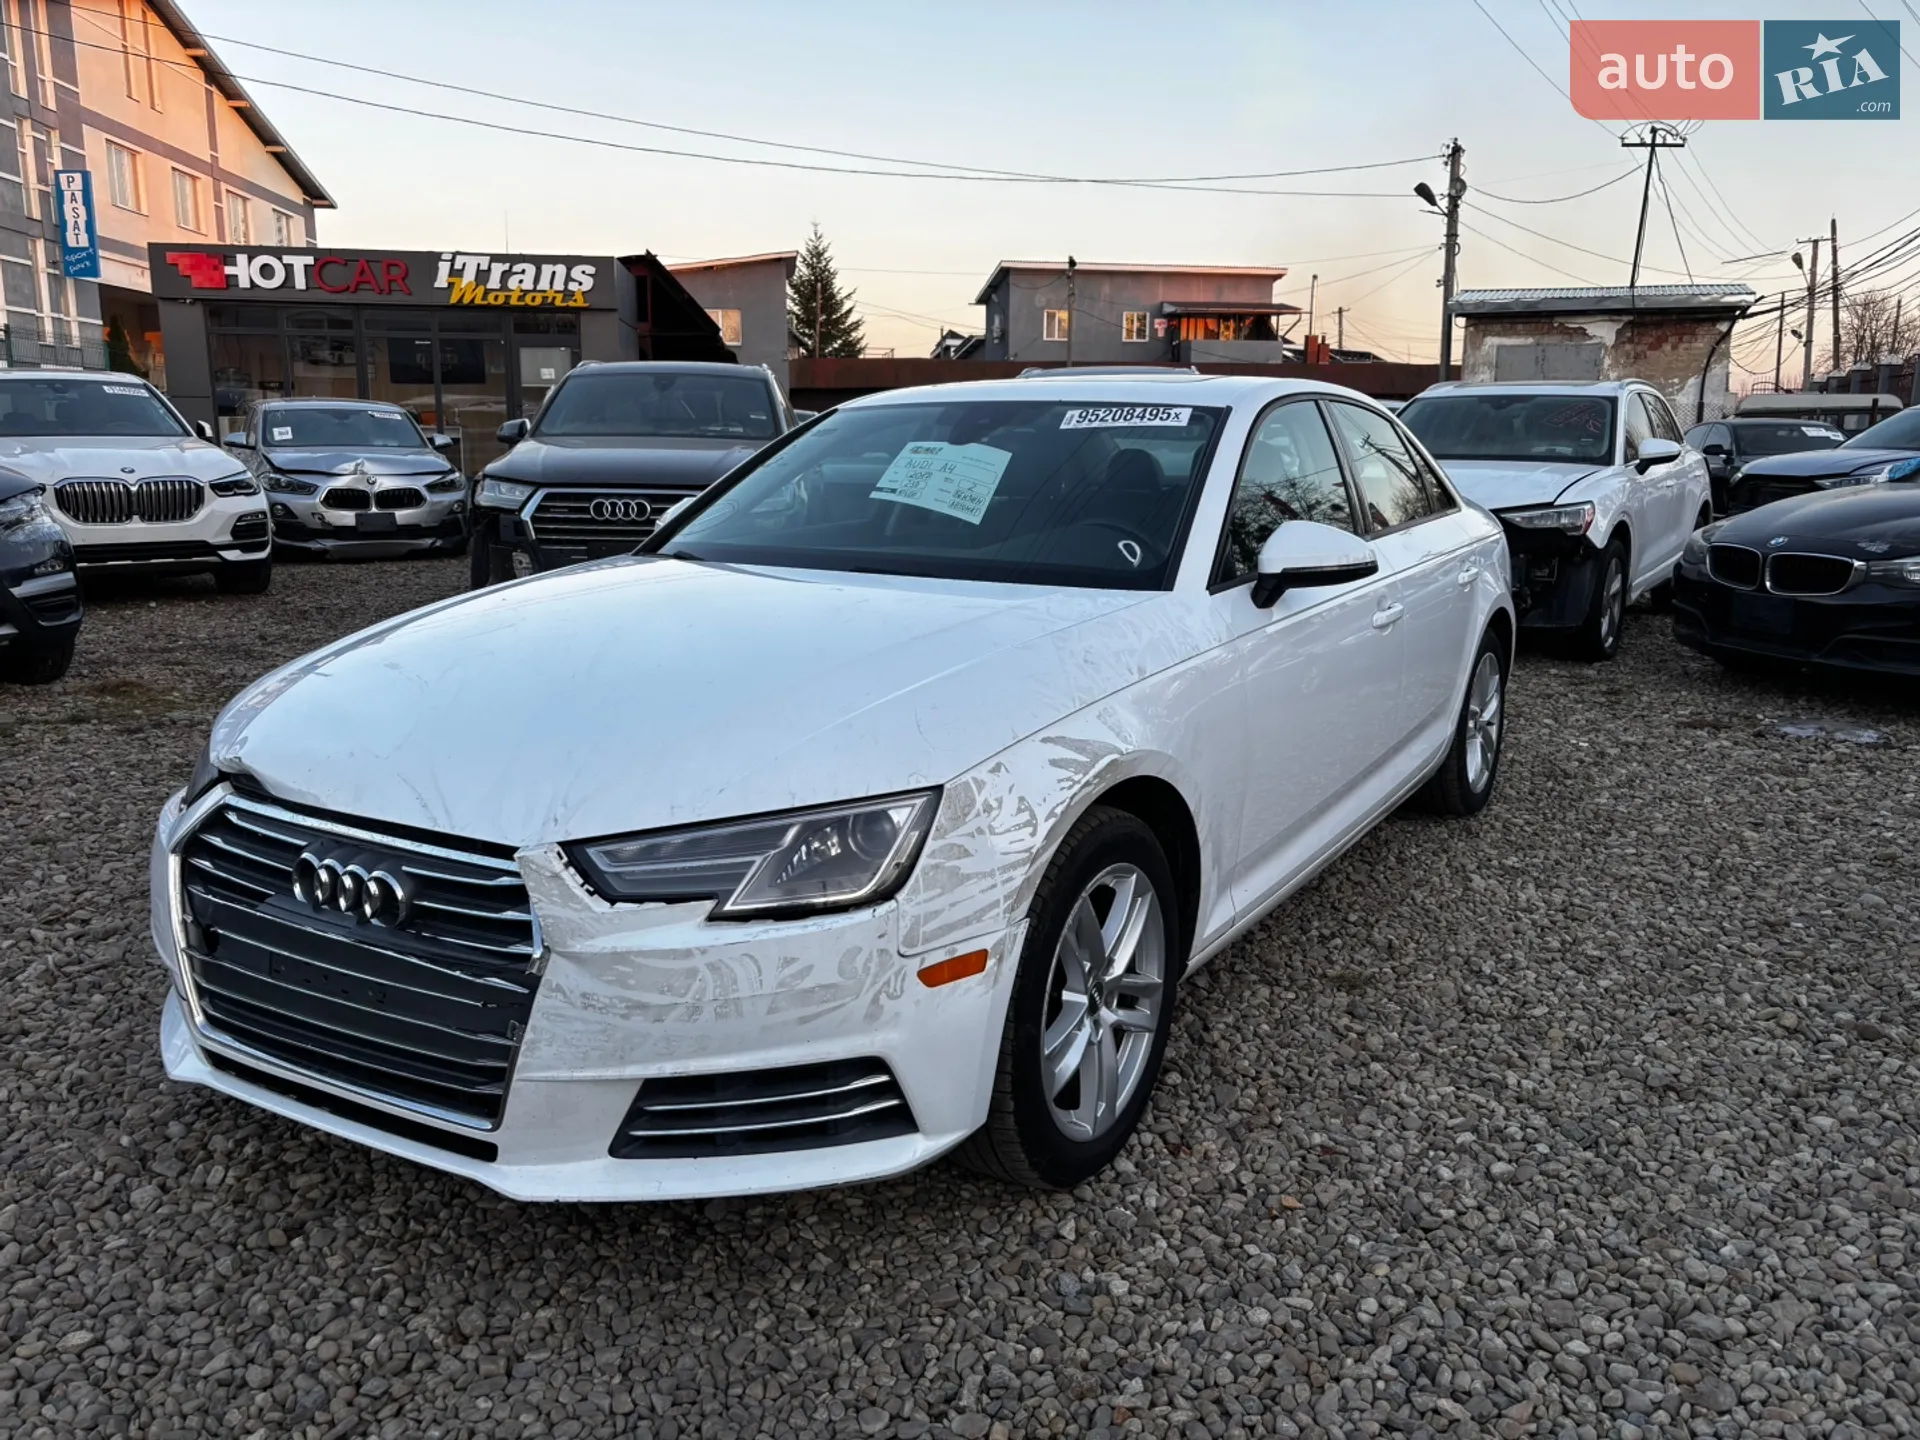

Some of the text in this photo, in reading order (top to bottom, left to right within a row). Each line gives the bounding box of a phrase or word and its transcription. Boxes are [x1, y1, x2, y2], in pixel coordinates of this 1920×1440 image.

[66, 175, 81, 245] PASAT
[65, 248, 95, 262] sport
[69, 261, 92, 274] park
[433, 252, 597, 292] iTrans
[446, 277, 589, 307] Motors
[905, 459, 958, 474] AUDI A4
